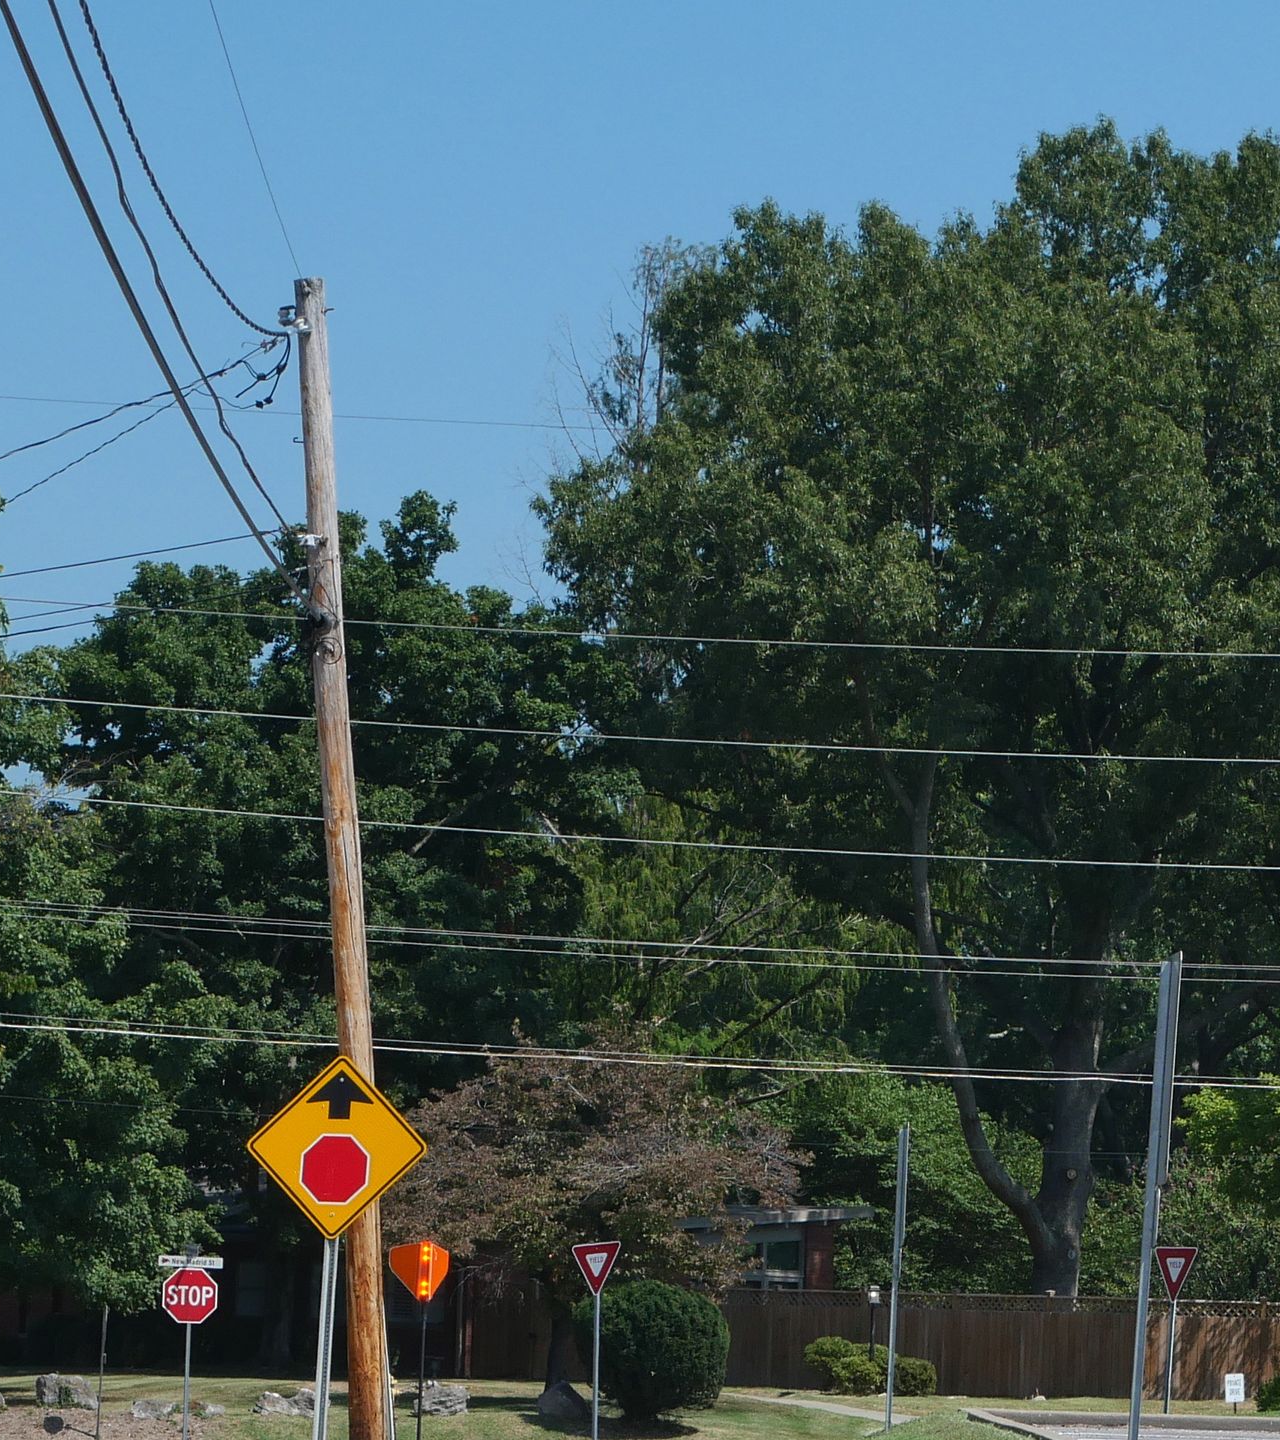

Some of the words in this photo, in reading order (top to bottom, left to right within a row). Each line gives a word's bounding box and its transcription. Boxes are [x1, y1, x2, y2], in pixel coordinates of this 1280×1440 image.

[208, 1259, 216, 1267] St
[589, 1256, 605, 1264] YIELD
[1168, 1261, 1183, 1269] YIELD
[166, 1285, 214, 1307] STOP
